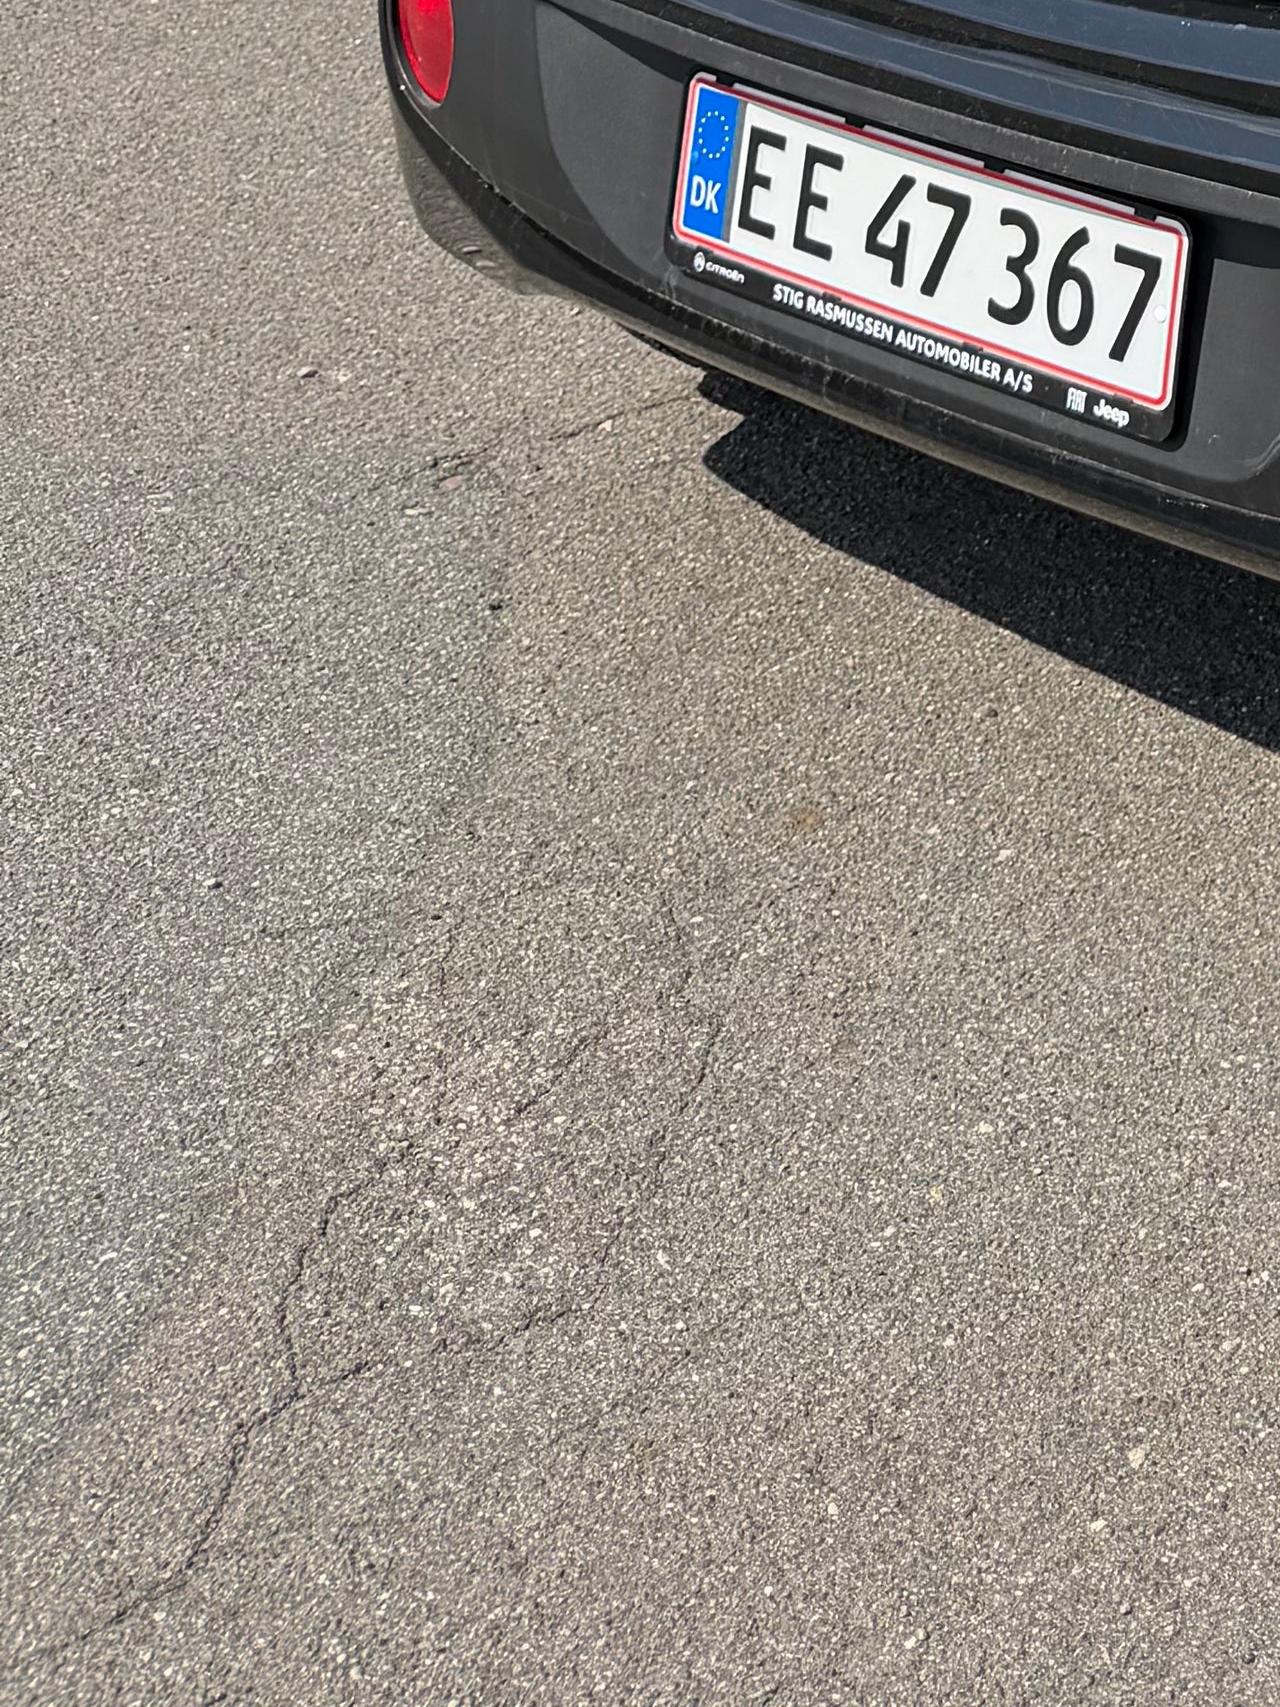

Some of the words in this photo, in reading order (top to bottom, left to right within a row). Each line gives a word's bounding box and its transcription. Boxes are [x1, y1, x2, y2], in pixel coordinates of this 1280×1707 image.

[690, 175, 721, 215] DK
[737, 125, 844, 262] EE
[865, 174, 972, 298] 47
[988, 208, 1163, 364] 367
[773, 283, 804, 309] STIG
[806, 295, 894, 343] RASMUSSEN
[897, 328, 1001, 381] AUTOMOBILER
[1003, 368, 1033, 393] A/S
[1066, 387, 1087, 413] FIAT
[1093, 398, 1130, 428] Jeep
